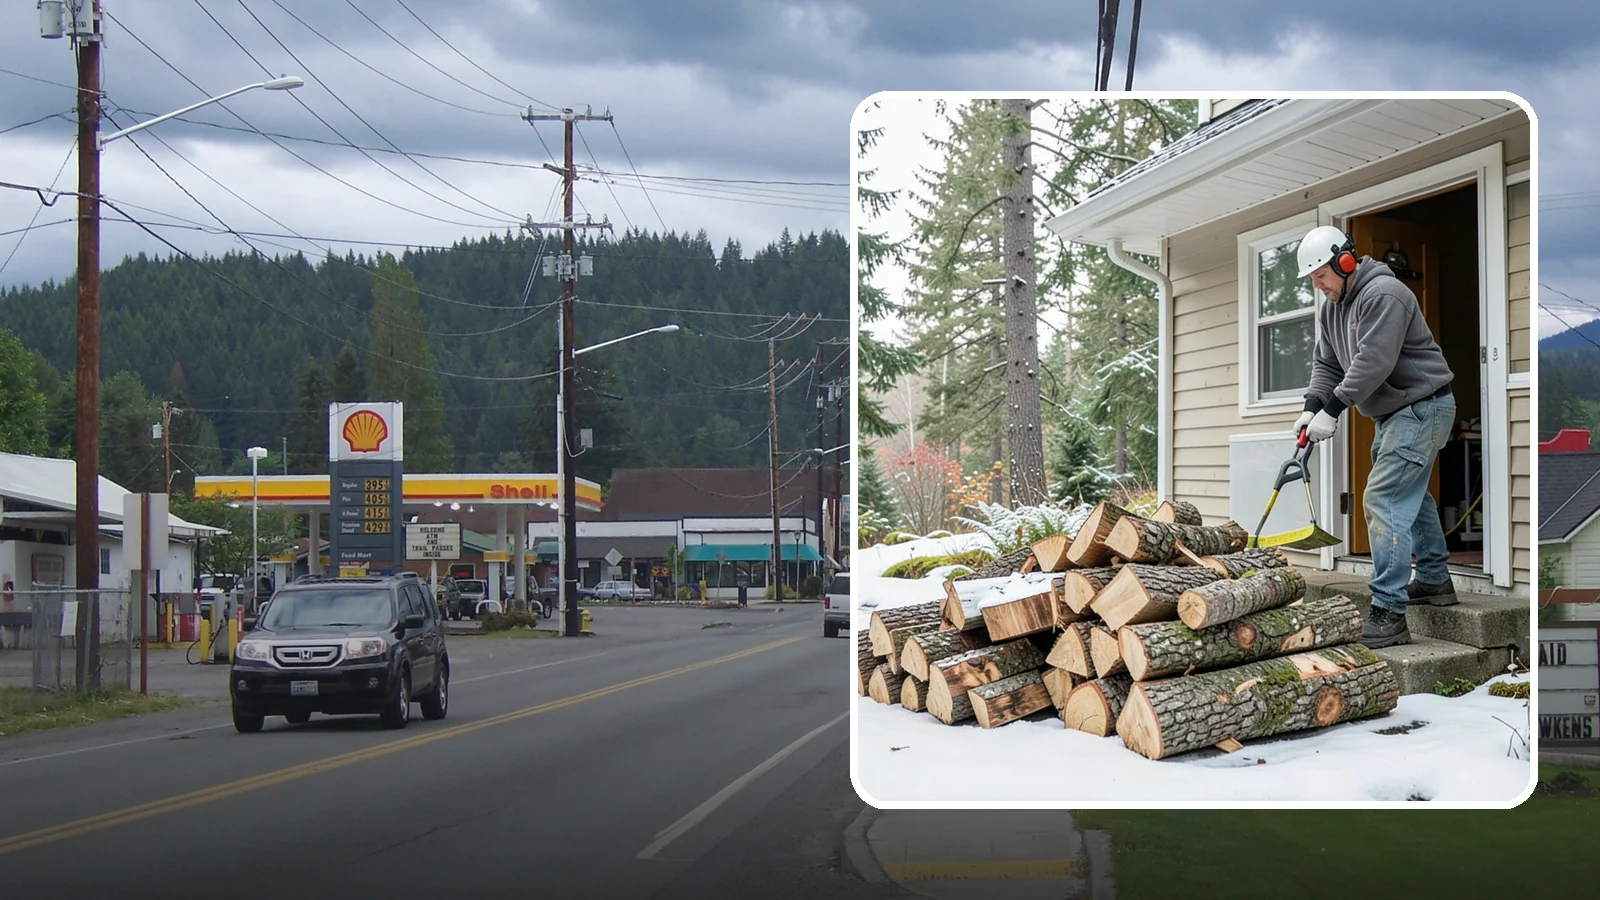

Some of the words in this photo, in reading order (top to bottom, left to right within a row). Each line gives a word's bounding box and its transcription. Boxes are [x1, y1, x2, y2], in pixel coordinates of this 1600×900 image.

[366, 480, 383, 490] 395
[490, 484, 547, 499] Shell
[365, 494, 383, 504] 405
[365, 508, 383, 518] 415
[365, 523, 383, 533] 429
